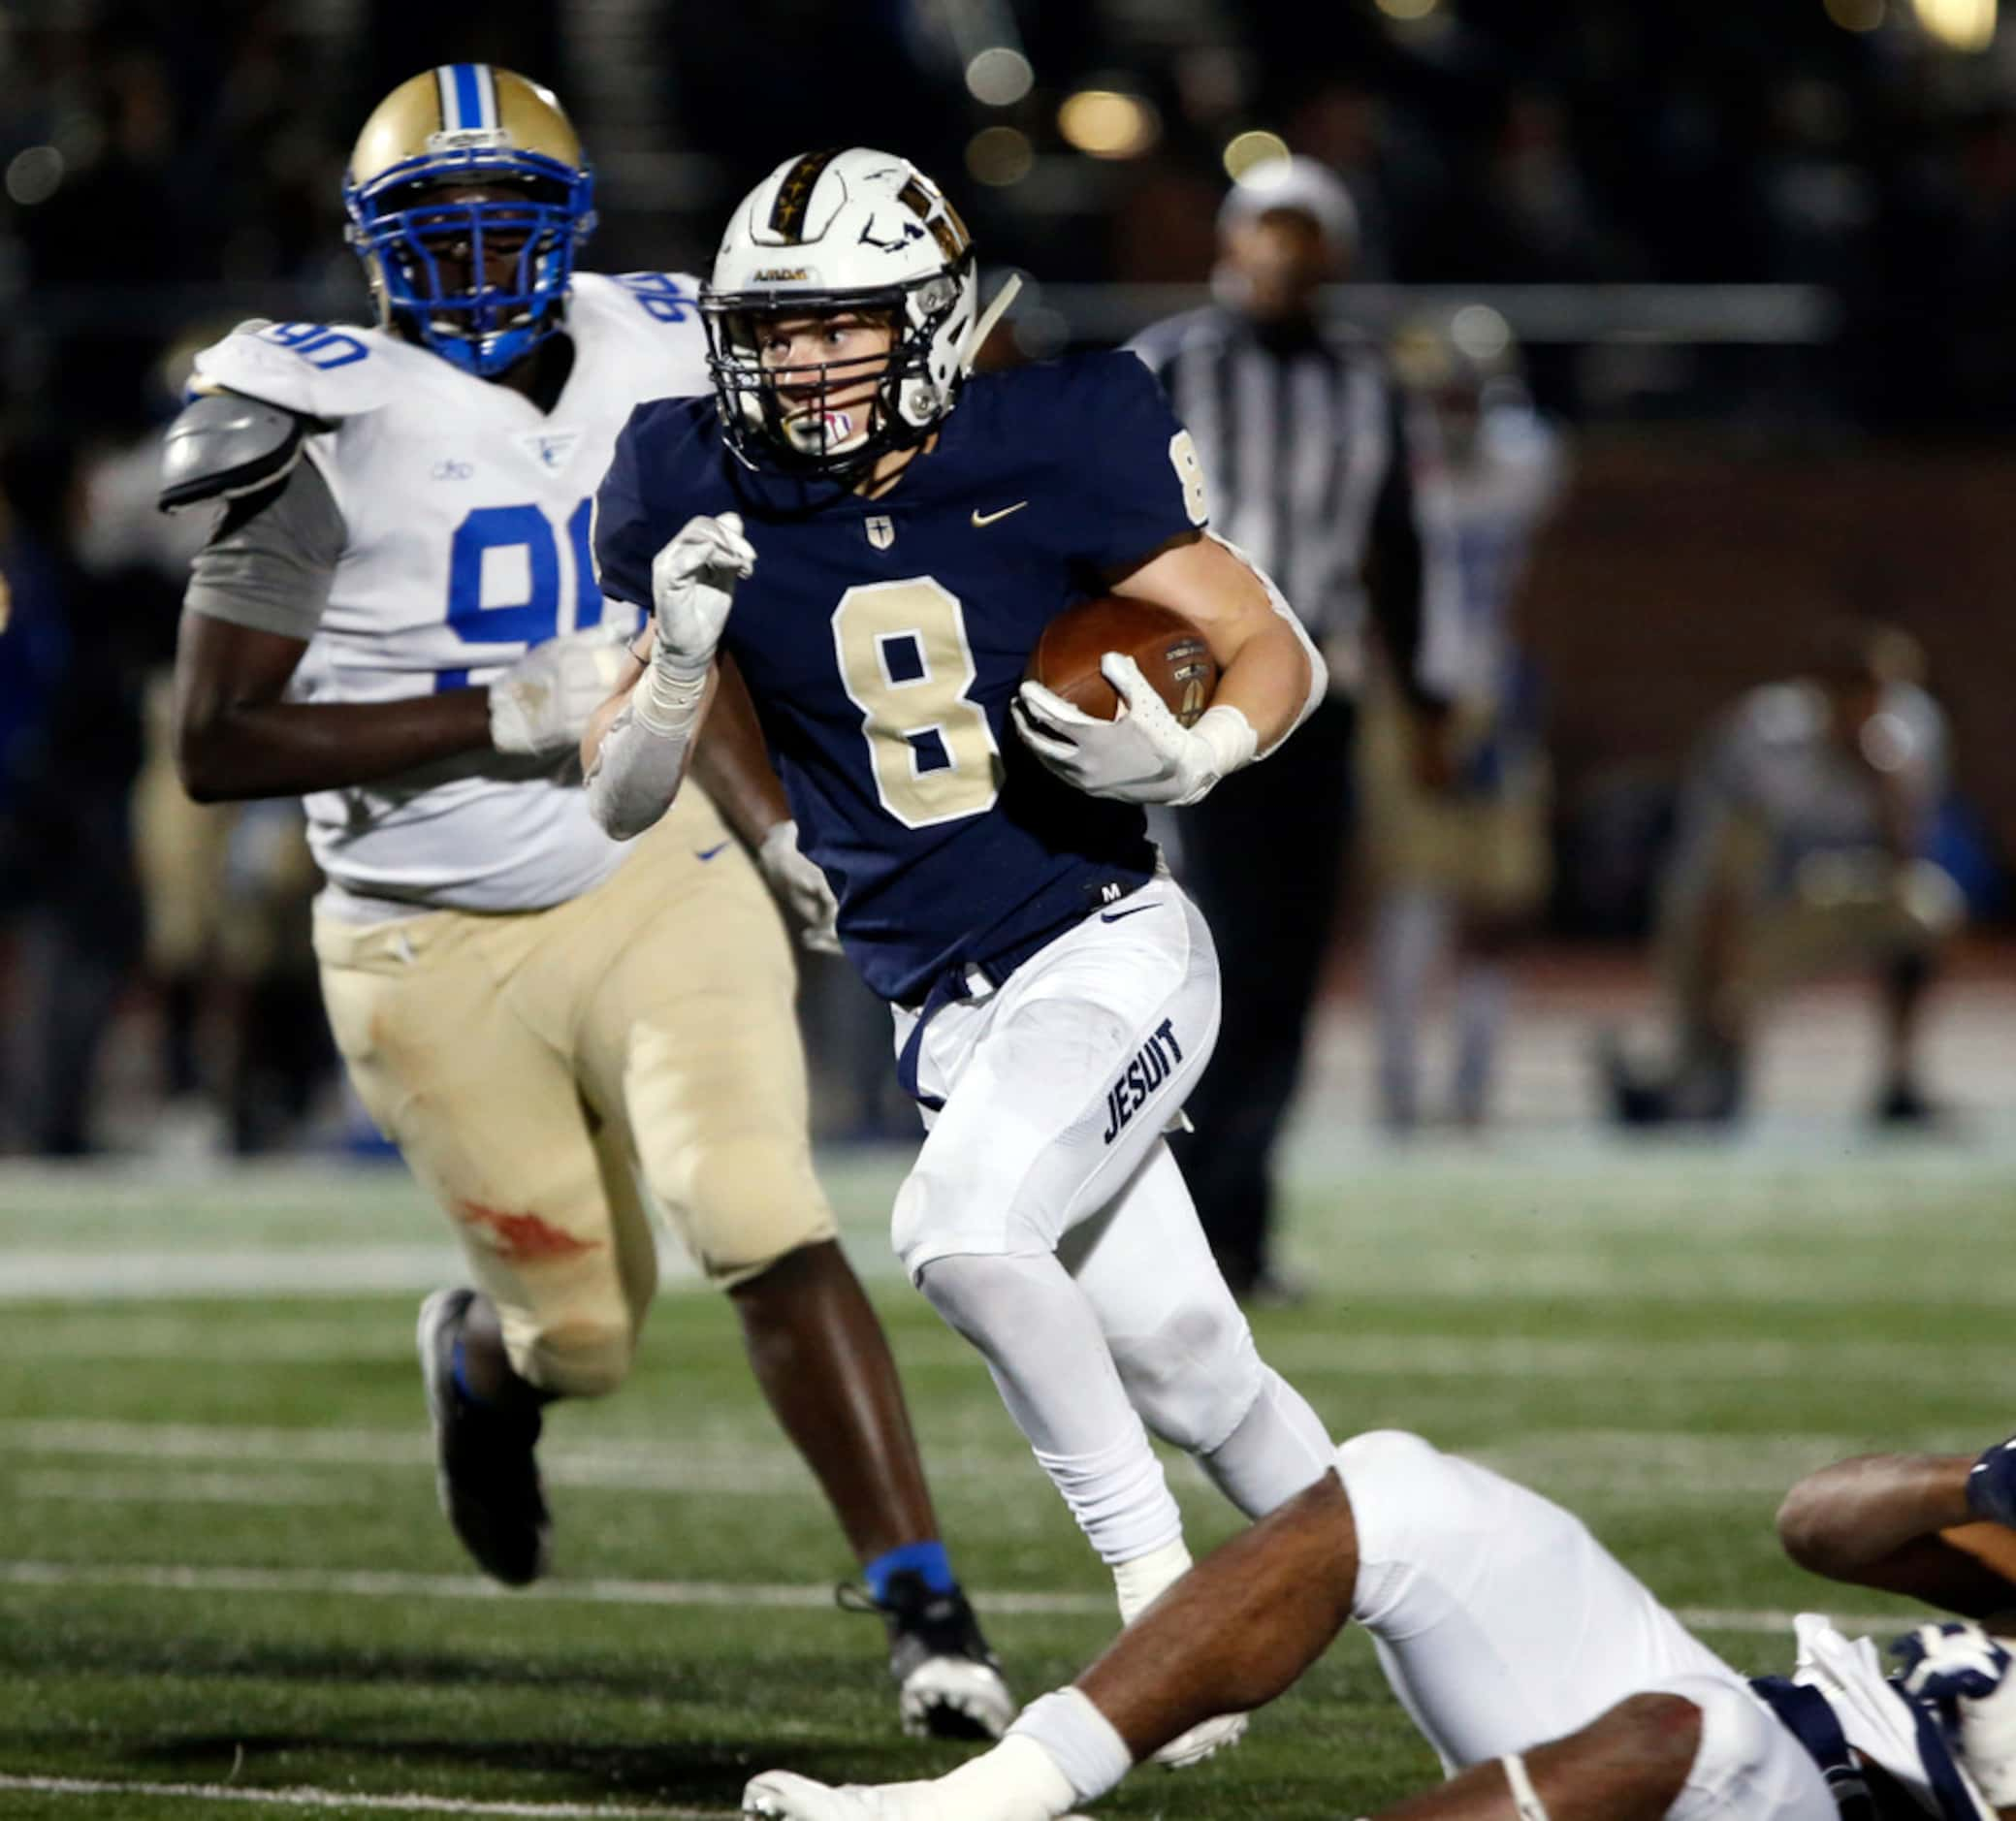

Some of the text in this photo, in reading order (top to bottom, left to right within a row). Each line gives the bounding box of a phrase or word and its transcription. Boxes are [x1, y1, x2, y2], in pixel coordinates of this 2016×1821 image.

[1168, 428, 1209, 526] 8
[831, 575, 1006, 830] 8
[1101, 882, 1121, 903] M
[1104, 1017, 1183, 1144] JESUIT
